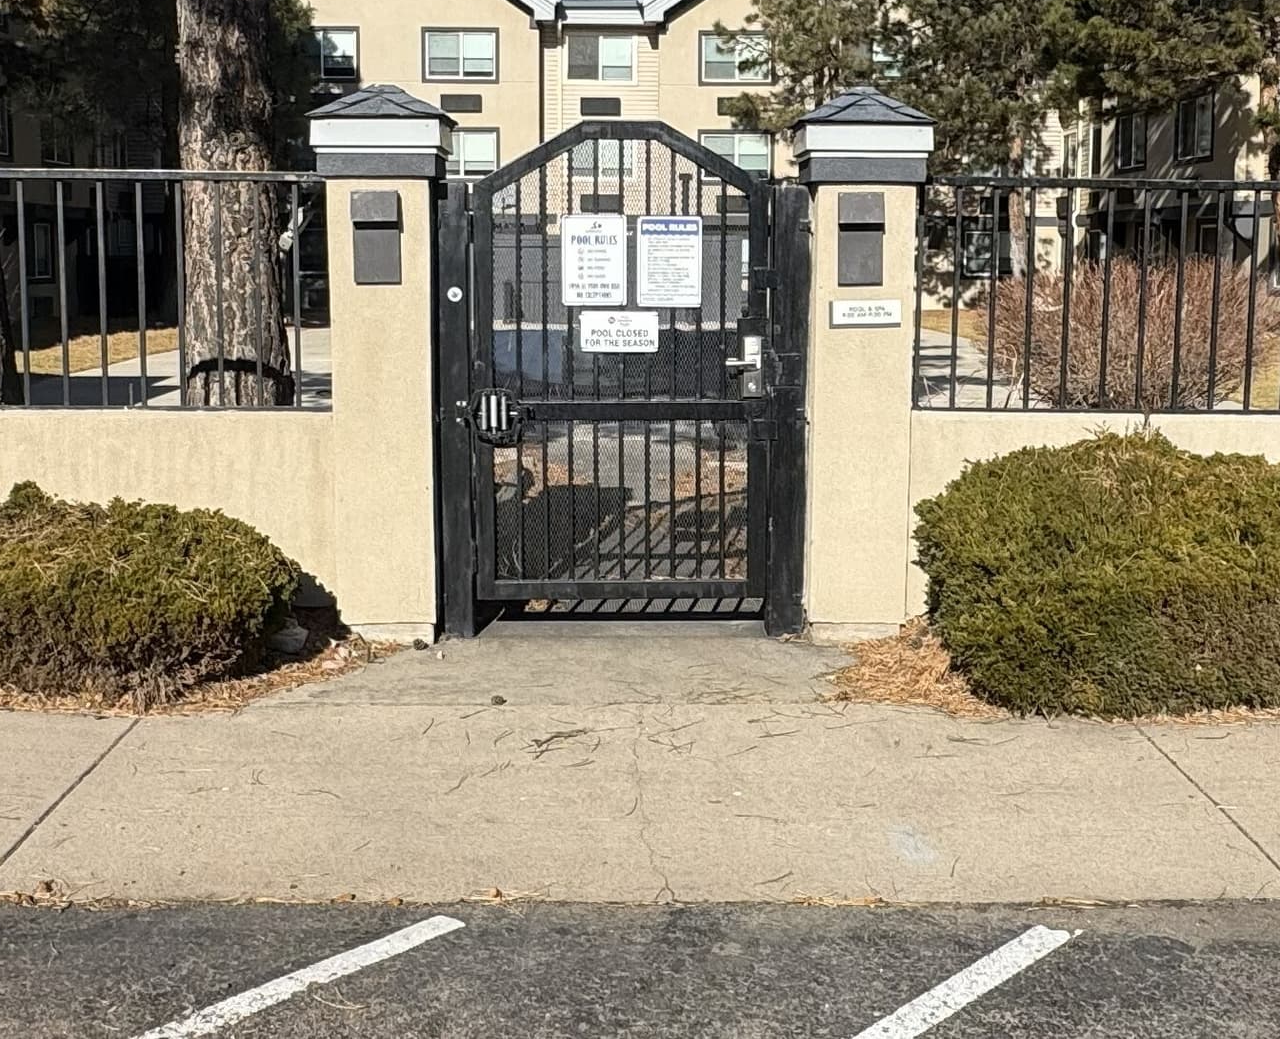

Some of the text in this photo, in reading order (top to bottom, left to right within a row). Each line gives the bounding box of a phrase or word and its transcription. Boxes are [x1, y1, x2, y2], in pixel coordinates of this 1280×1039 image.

[642, 223, 698, 232] POOL RULES
[571, 234, 618, 246] POOL RULES
[590, 329, 649, 337] POOL CLOSED
[585, 339, 656, 347] FOR THE SEASON
